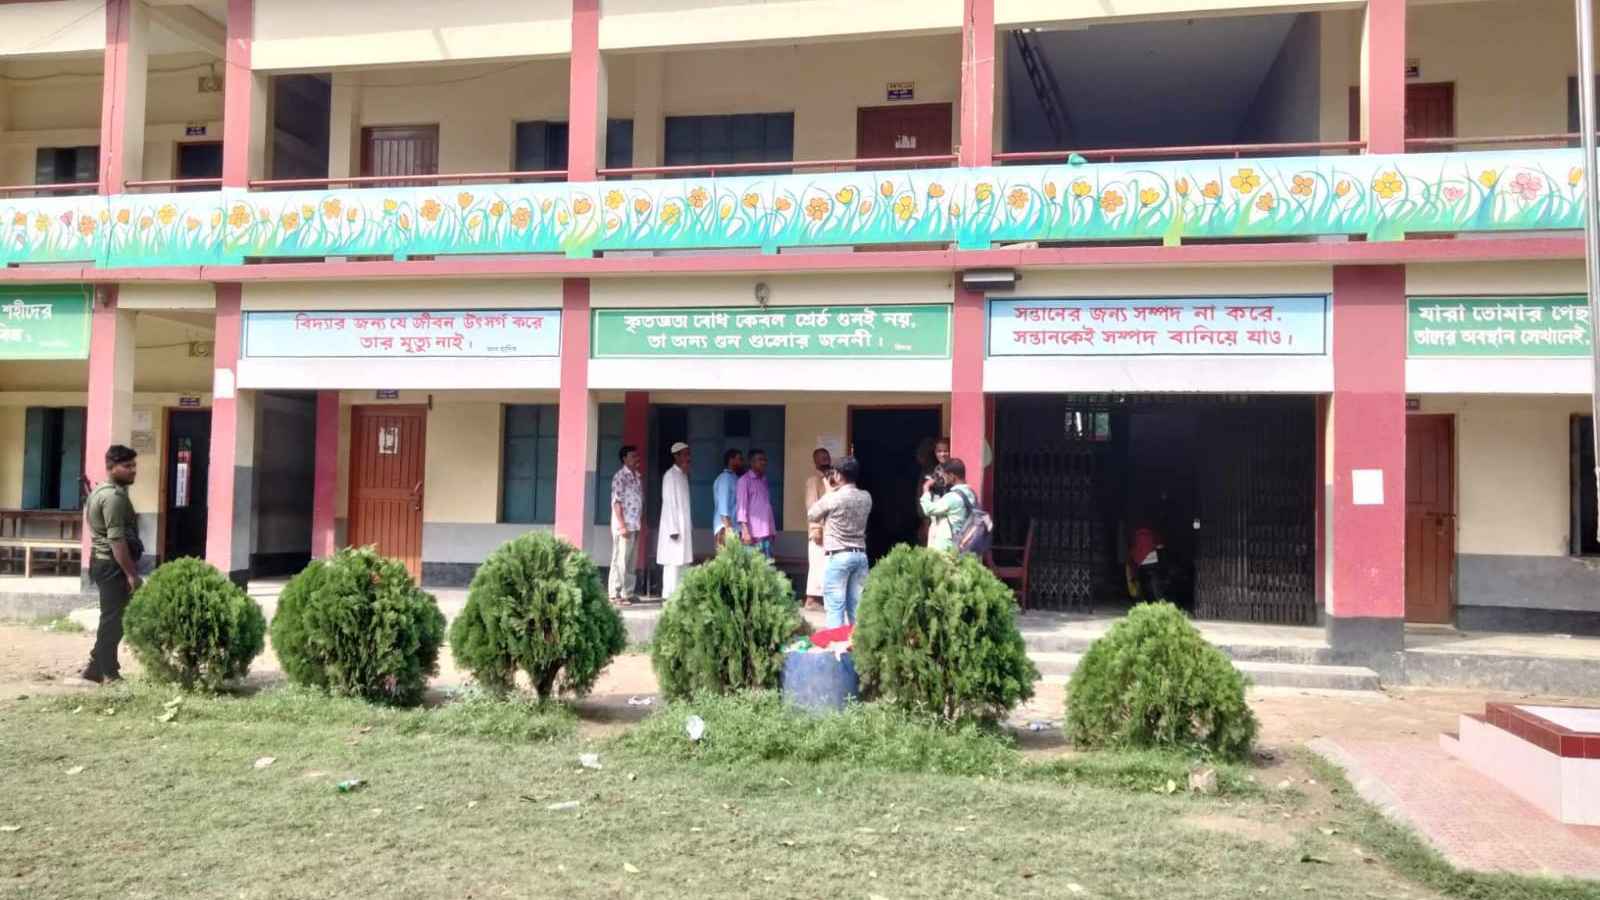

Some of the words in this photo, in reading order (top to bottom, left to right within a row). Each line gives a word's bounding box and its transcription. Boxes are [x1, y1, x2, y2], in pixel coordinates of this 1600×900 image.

[295, 312, 345, 330] বিদ্যার
[353, 317, 386, 329] জন্য
[391, 316, 407, 329] যে
[412, 311, 456, 329] জীবন
[463, 312, 508, 329] উৎসর্গ
[511, 316, 544, 330] করে
[735, 313, 786, 328] কেবল
[1013, 305, 1082, 321] সন্তানের
[1089, 306, 1128, 322] জন্য
[1132, 305, 1184, 321] সম্পদ
[1192, 305, 1216, 320] না
[1419, 304, 1466, 322] যারা
[1472, 304, 1544, 322] তোমার
[647, 332, 667, 348] তা
[671, 335, 708, 348] অন্য
[714, 335, 742, 348] গুন
[748, 333, 810, 350] গুলোর
[1012, 325, 1095, 345] সন্তানকেই
[1101, 329, 1158, 345] সম্পদ
[1167, 324, 1238, 346] বানিয়ে
[360, 336, 393, 350] তার
[400, 336, 432, 353] মৃত্যু
